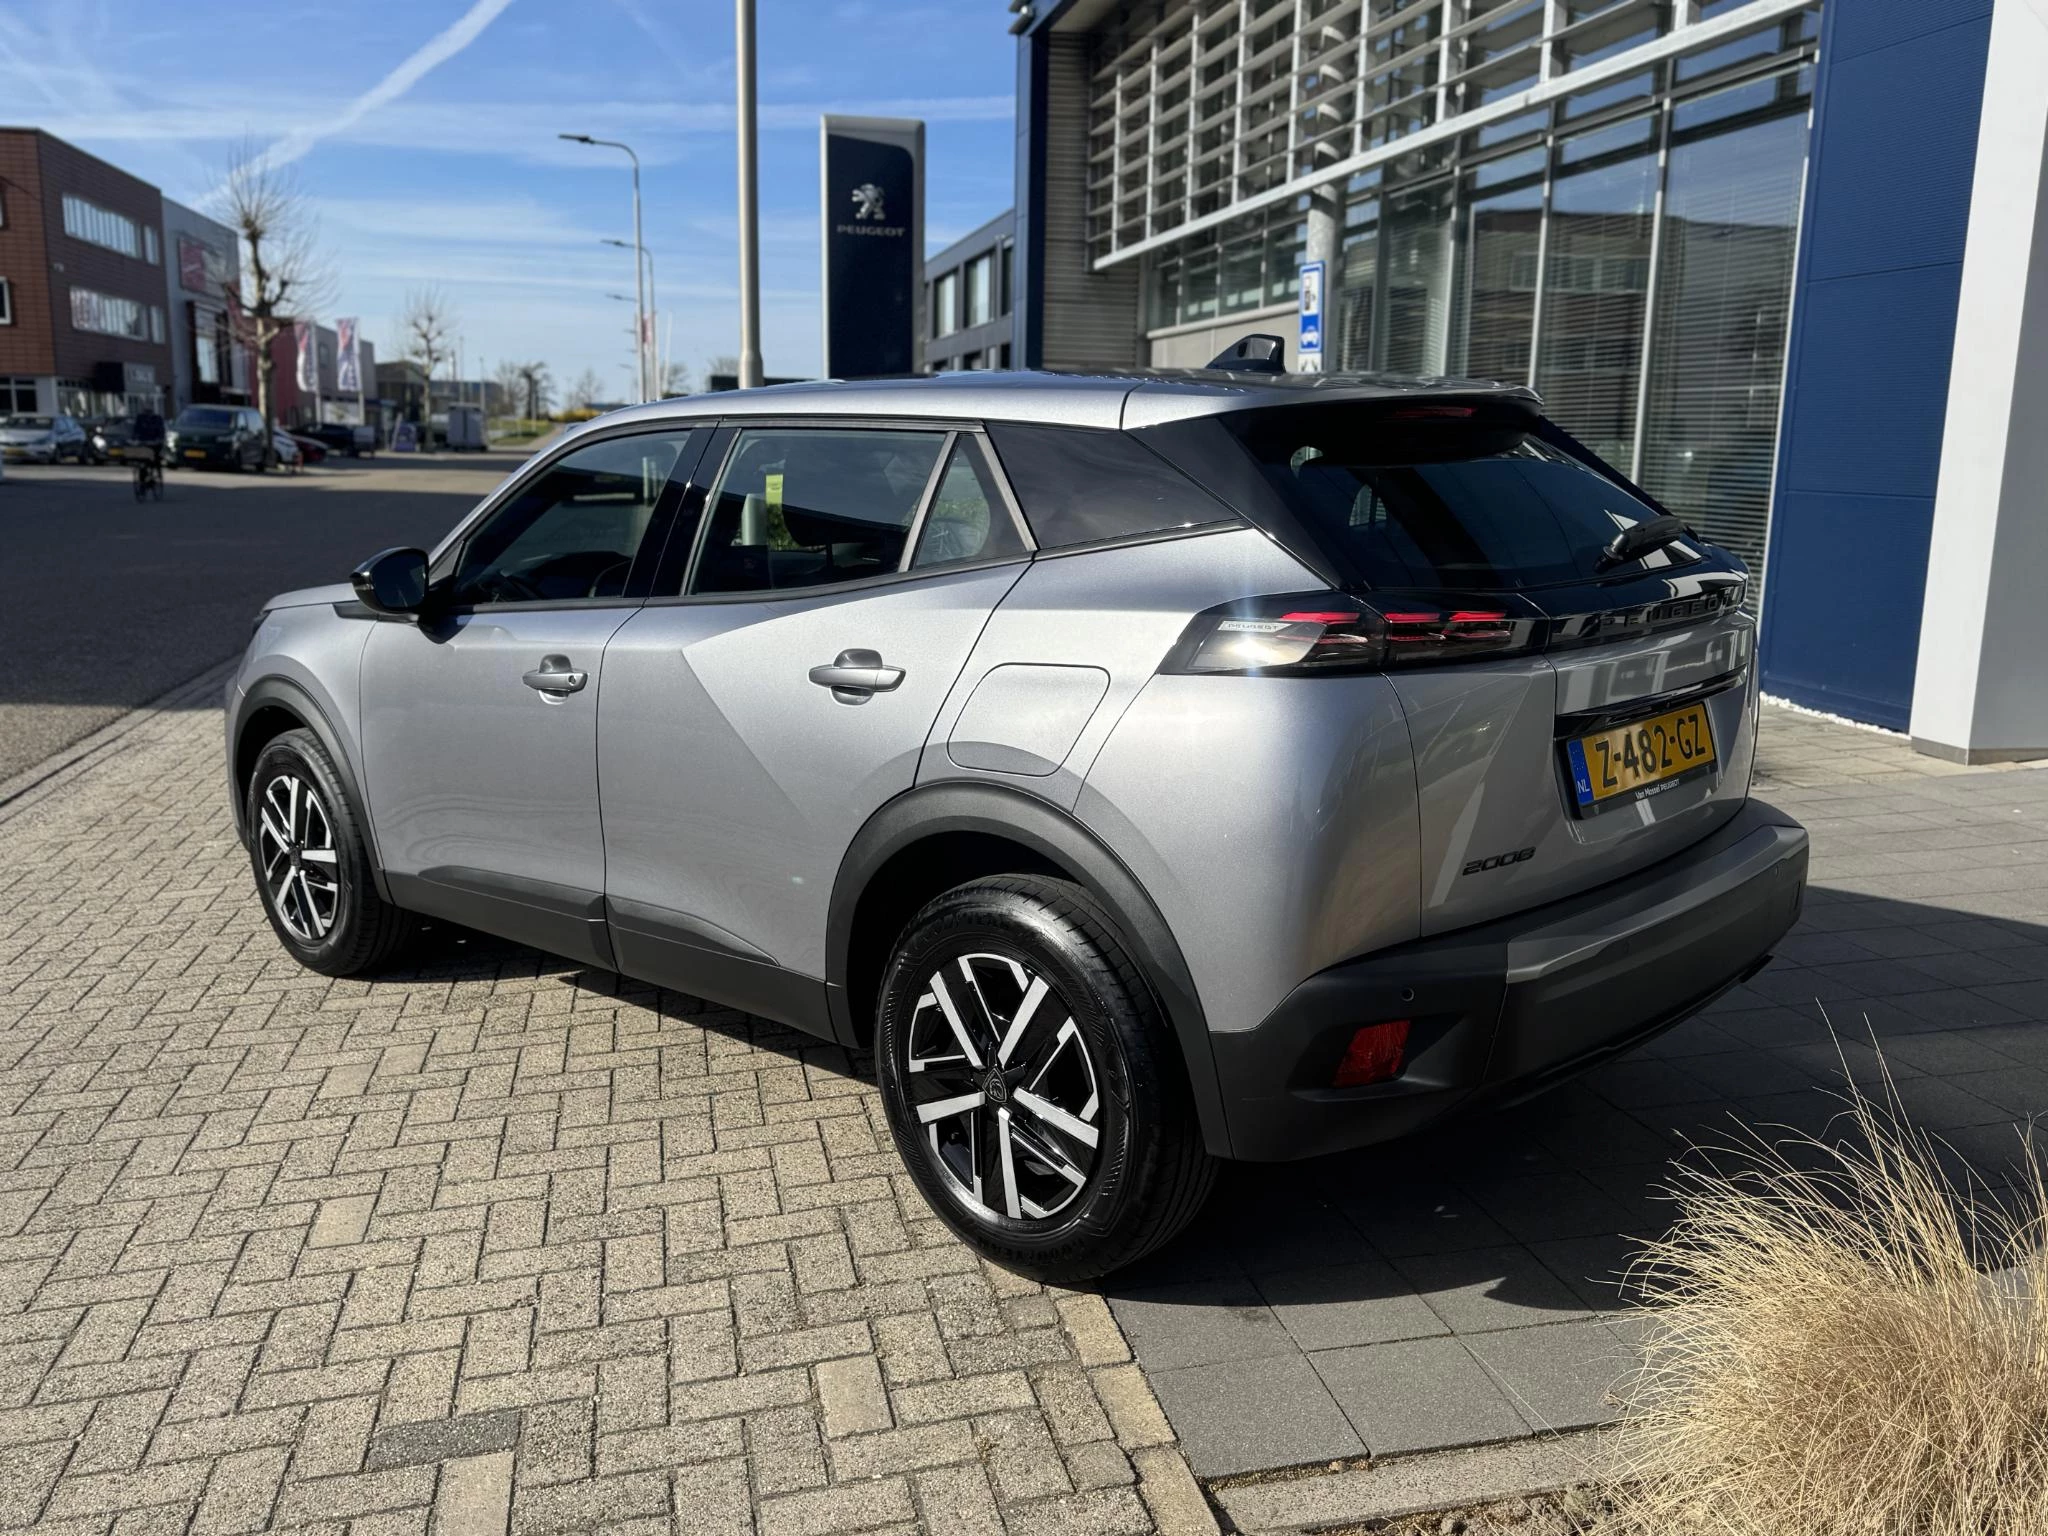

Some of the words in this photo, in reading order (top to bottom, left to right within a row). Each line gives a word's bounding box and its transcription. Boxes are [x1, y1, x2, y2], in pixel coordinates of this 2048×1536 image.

[836, 225, 906, 237] PEUGEOT
[1595, 714, 1706, 788] Z-482-GZ
[1577, 780, 1590, 793] NL
[1635, 791, 1645, 800] Van
[1462, 846, 1537, 876] 2008
